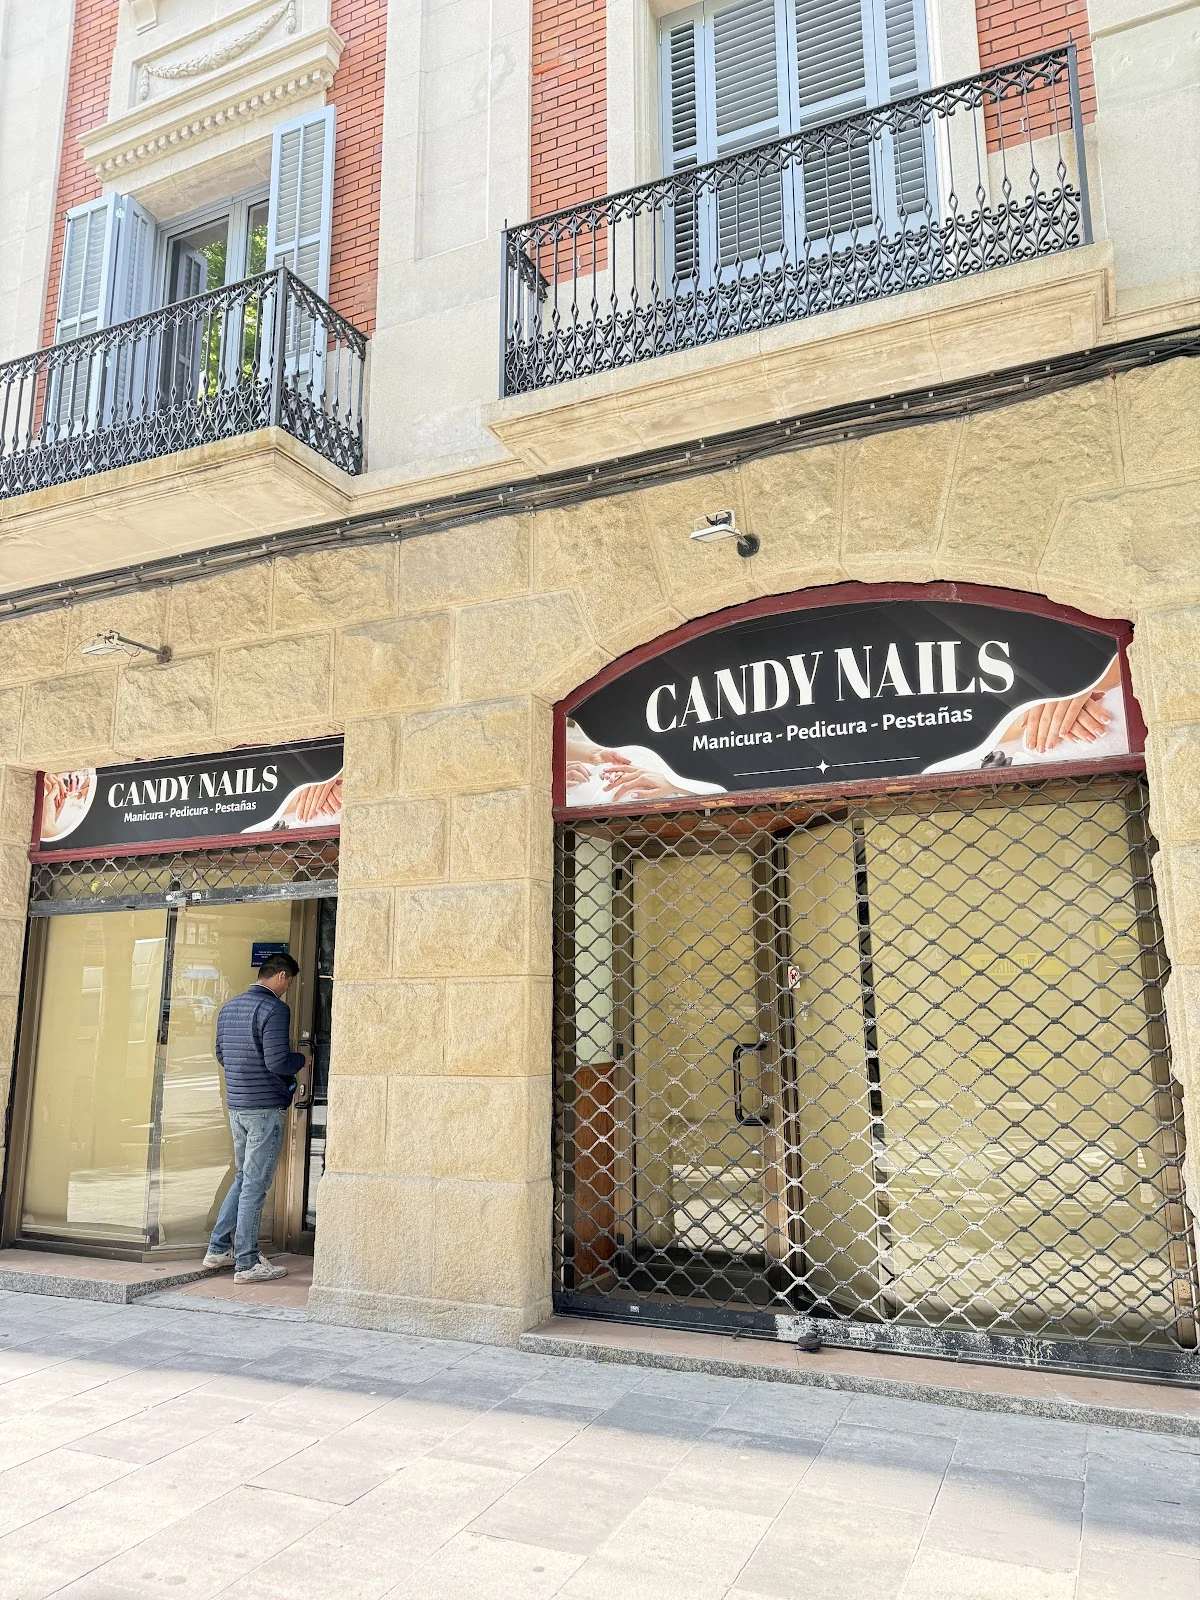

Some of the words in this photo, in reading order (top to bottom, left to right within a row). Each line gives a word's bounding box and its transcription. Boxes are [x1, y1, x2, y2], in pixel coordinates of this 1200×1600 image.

[646, 651, 823, 733] CANDY
[834, 640, 1015, 702] NAILS
[692, 731, 772, 751] Manicura
[786, 721, 867, 741] Pedicura
[882, 706, 973, 730] Pestañas
[107, 774, 195, 809] CANDY
[198, 765, 278, 799] NAILS
[124, 810, 164, 823] Manicura
[170, 806, 208, 818] Pedicura
[215, 800, 257, 814] Pestañas
